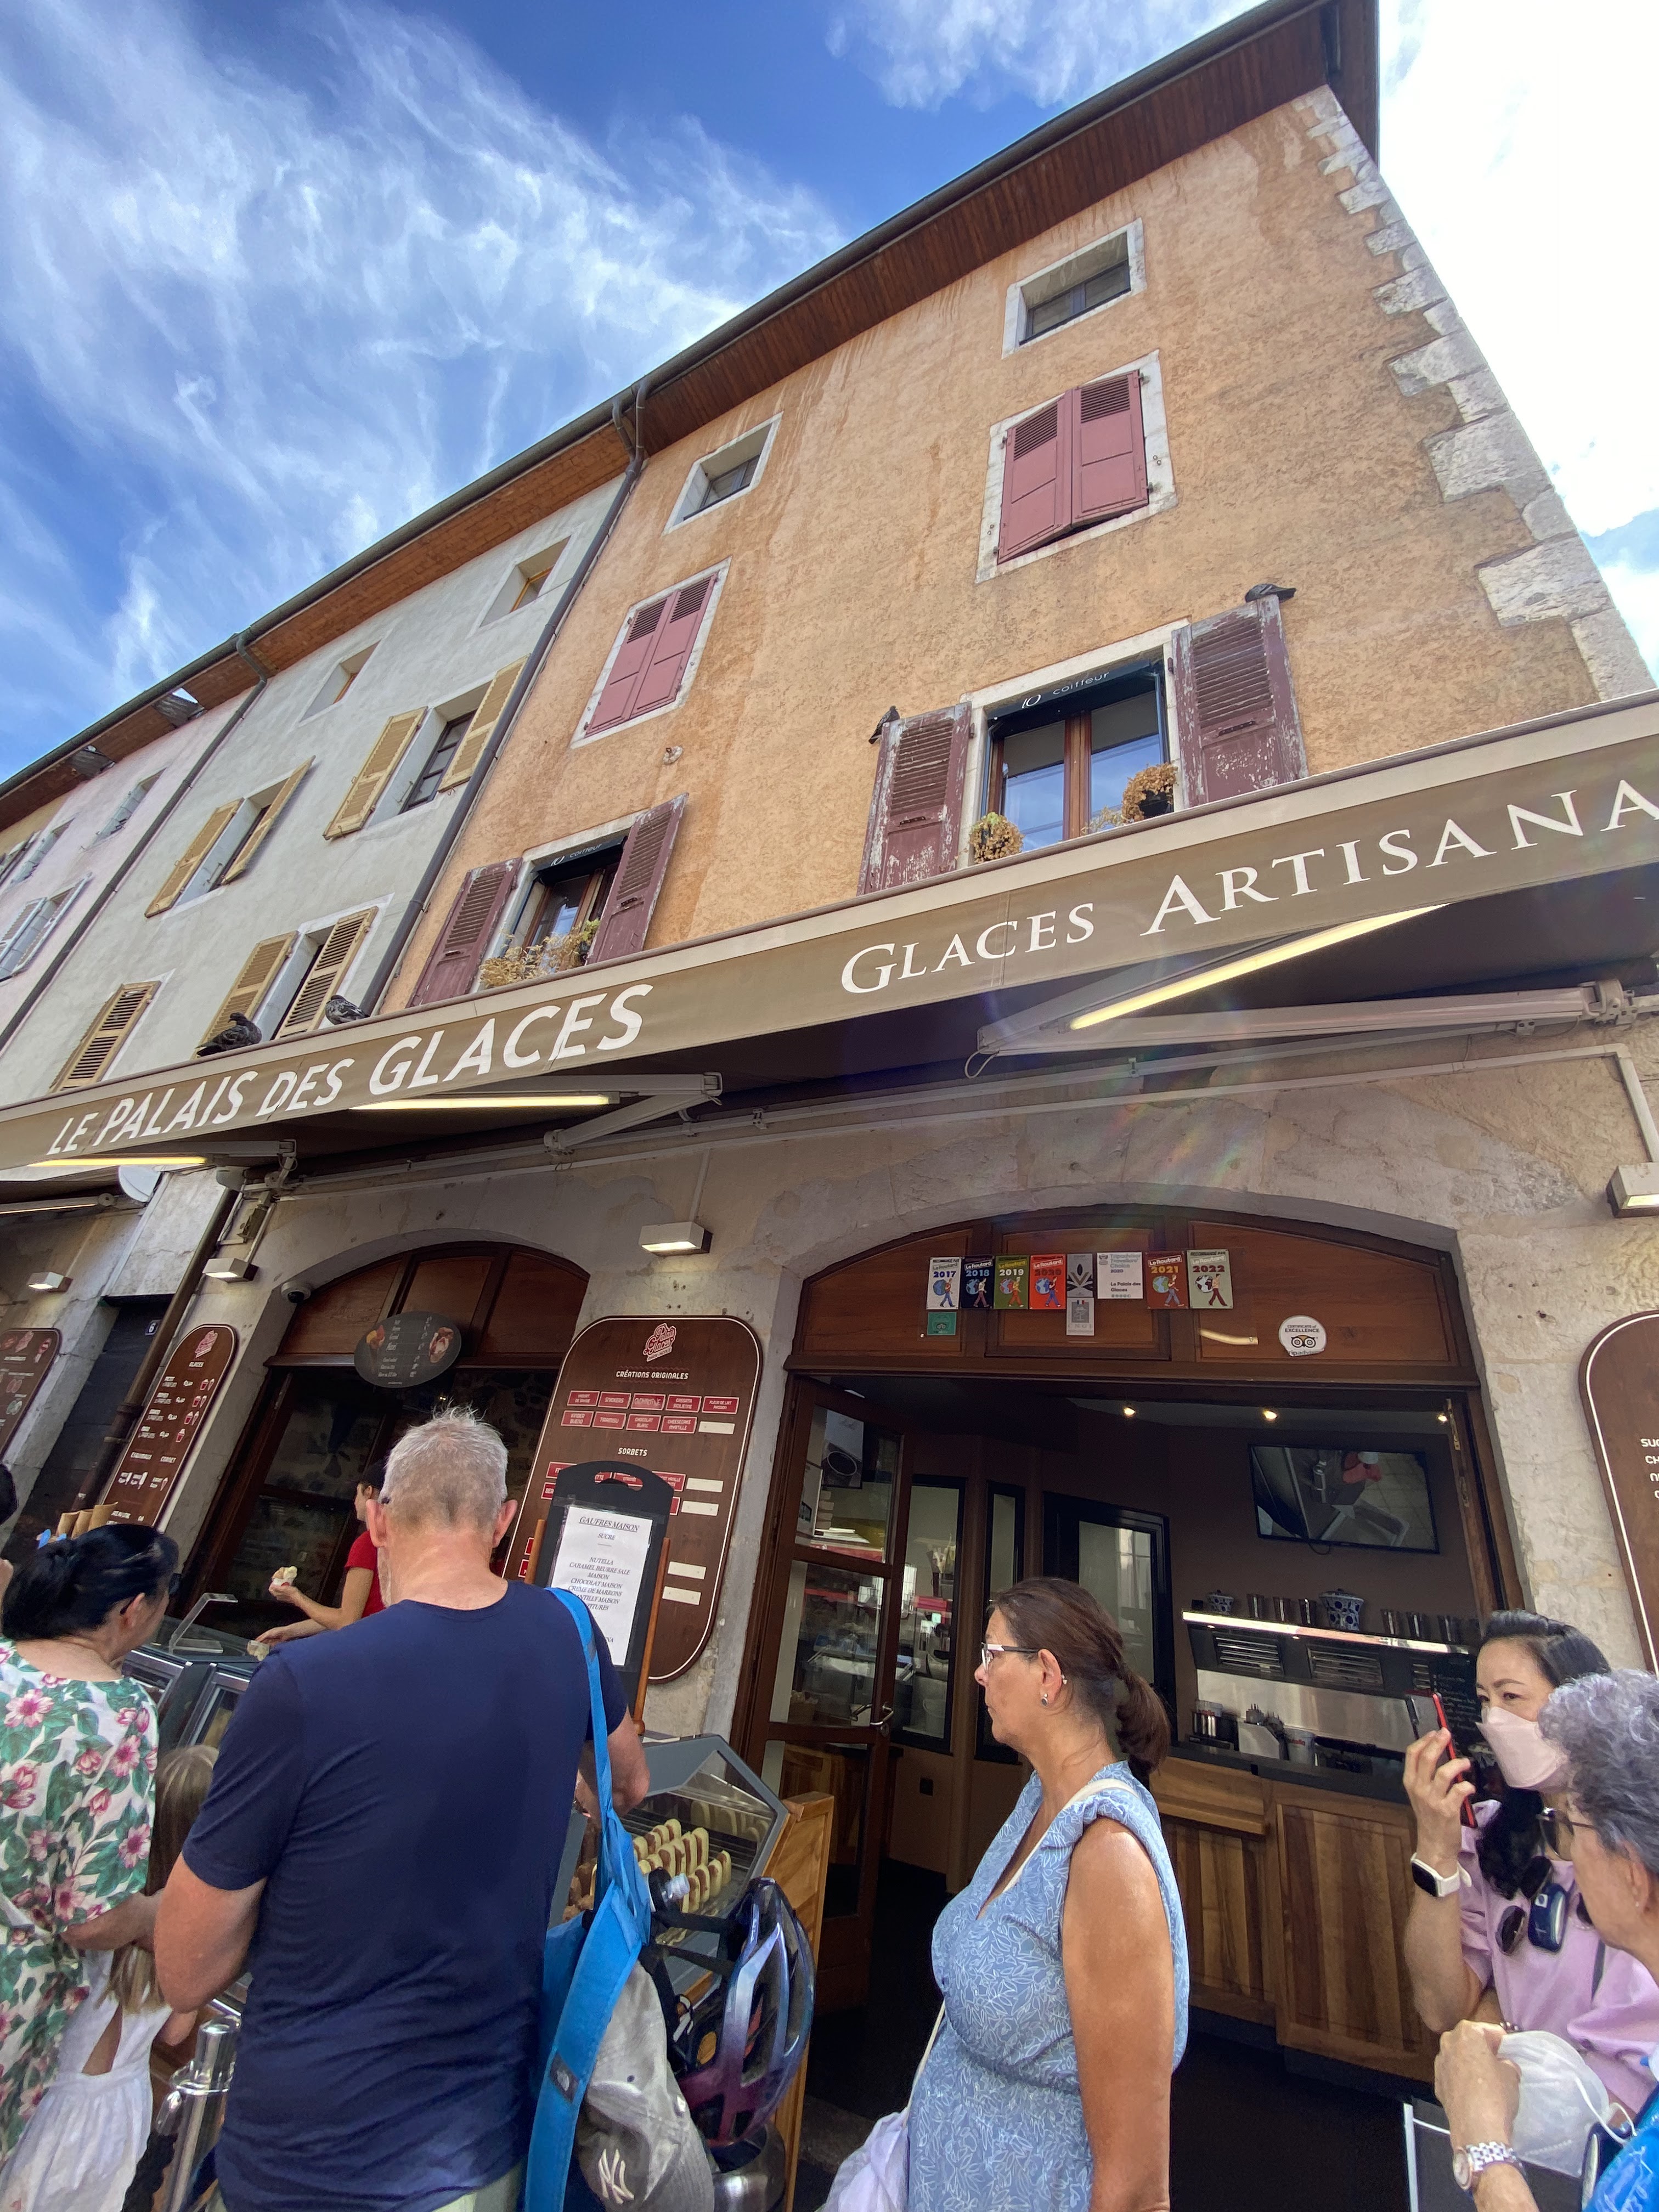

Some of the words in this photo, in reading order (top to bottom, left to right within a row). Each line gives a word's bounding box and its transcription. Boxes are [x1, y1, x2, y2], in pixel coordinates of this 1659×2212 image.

[841, 902, 1094, 994] GLACES
[46, 1111, 99, 1155] LE
[92, 1070, 258, 1147] PALAIS
[255, 1058, 356, 1117] DES
[369, 984, 654, 1096] GLACES
[1199, 1255, 1224, 1263] Routard
[1193, 1265, 1225, 1273] 2022
[149, 1322, 156, 1333] 6
[616, 1369, 650, 1378] CRÉATIONS
[618, 1447, 648, 1457] SORBETS
[579, 1516, 612, 1527] GAUFRES
[612, 1521, 640, 1532] MAISON
[589, 1557, 614, 1565] NUTELLA
[569, 1562, 595, 1570] CARAMEL
[595, 1565, 618, 1573] BEURRE
[571, 1578, 602, 1587] CHOCOLAT
